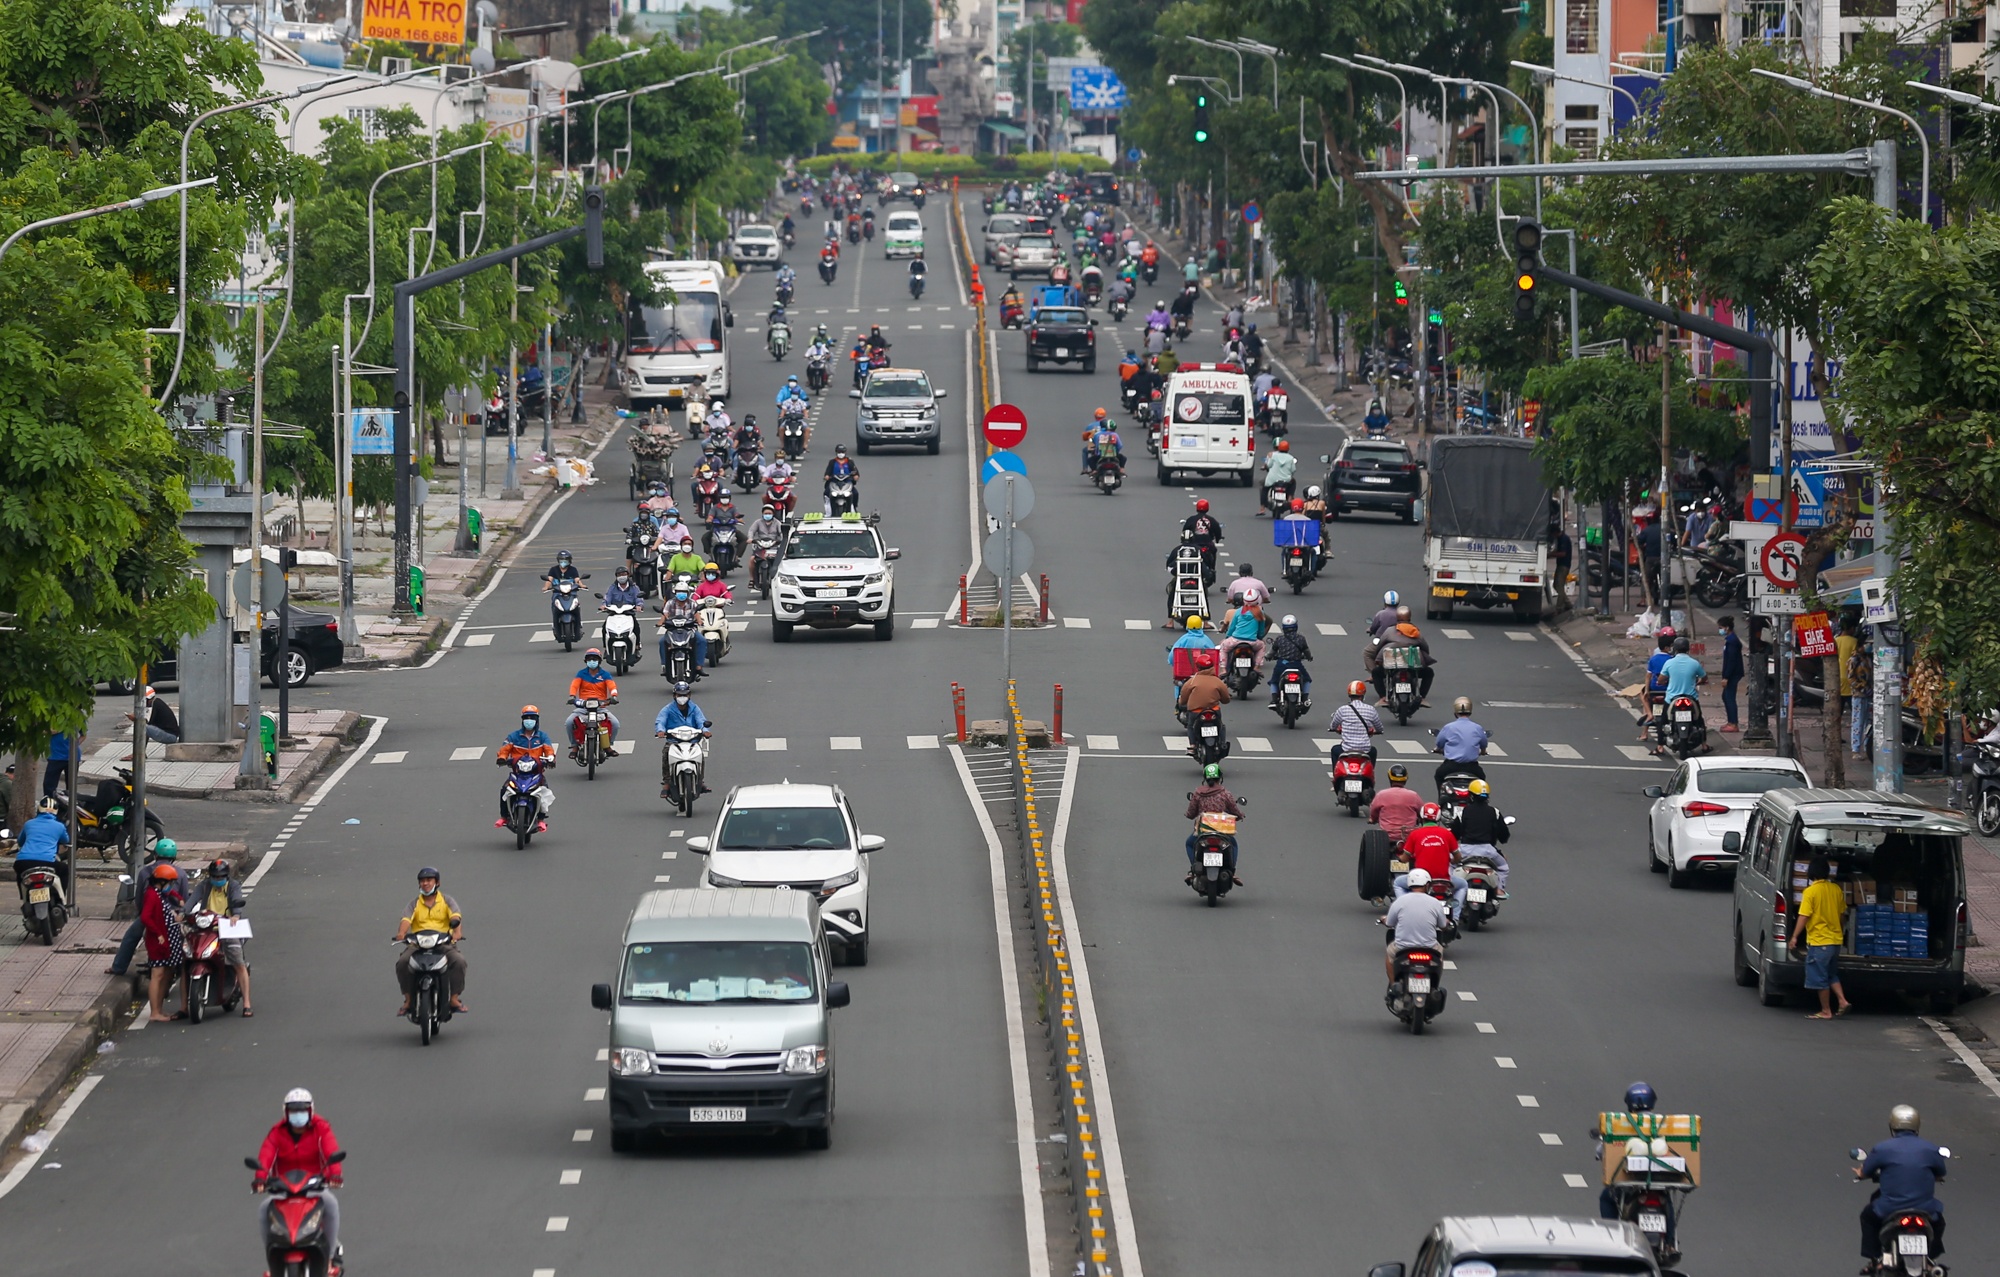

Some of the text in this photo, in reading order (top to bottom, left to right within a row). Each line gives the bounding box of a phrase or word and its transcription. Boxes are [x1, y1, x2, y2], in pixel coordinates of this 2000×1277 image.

[419, 1, 462, 28] TRỌ
[368, 26, 458, 43] 0908.166.686
[1182, 380, 1238, 389] AMBULANCE
[1767, 600, 1781, 608] 6:00
